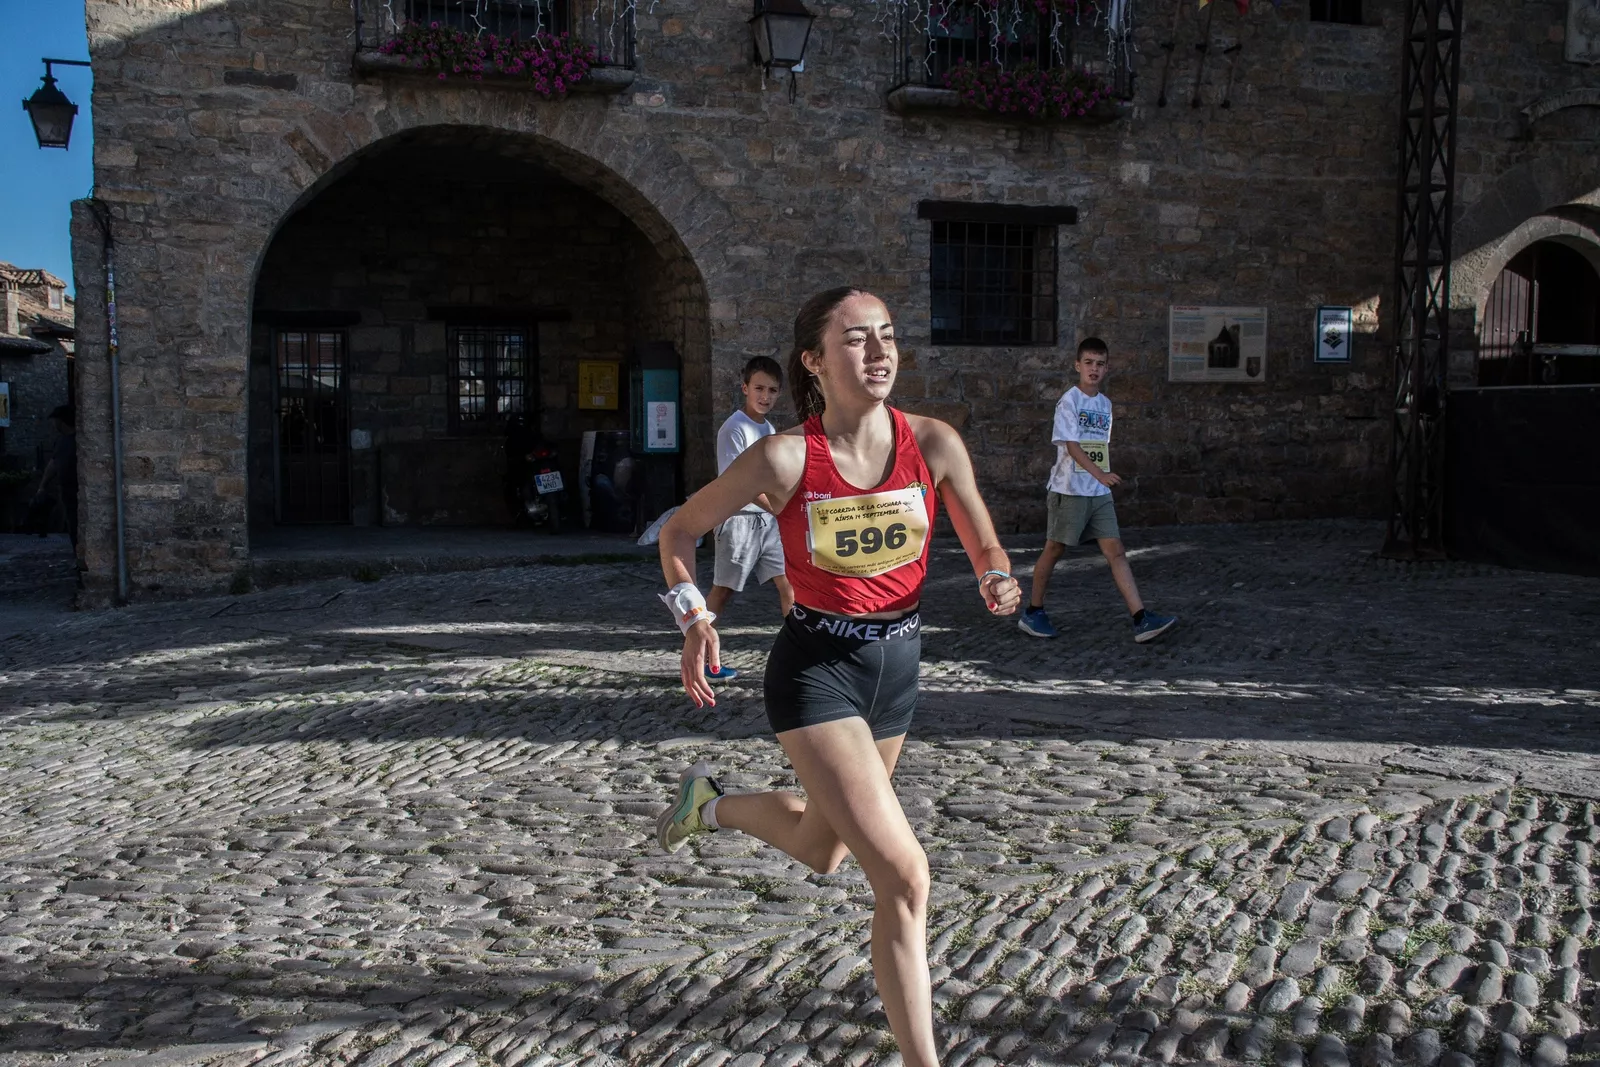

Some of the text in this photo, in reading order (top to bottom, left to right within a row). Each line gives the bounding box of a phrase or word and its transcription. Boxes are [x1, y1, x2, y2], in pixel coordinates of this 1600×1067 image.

[541, 473, 559, 482] 4234
[829, 506, 856, 515] CORRIDA
[876, 500, 902, 509] CUCHARA
[834, 513, 854, 522] AÍNSA
[862, 508, 900, 519] SEPTIEMBRE
[835, 523, 907, 558] 596
[815, 612, 920, 641] NIKE PRO
